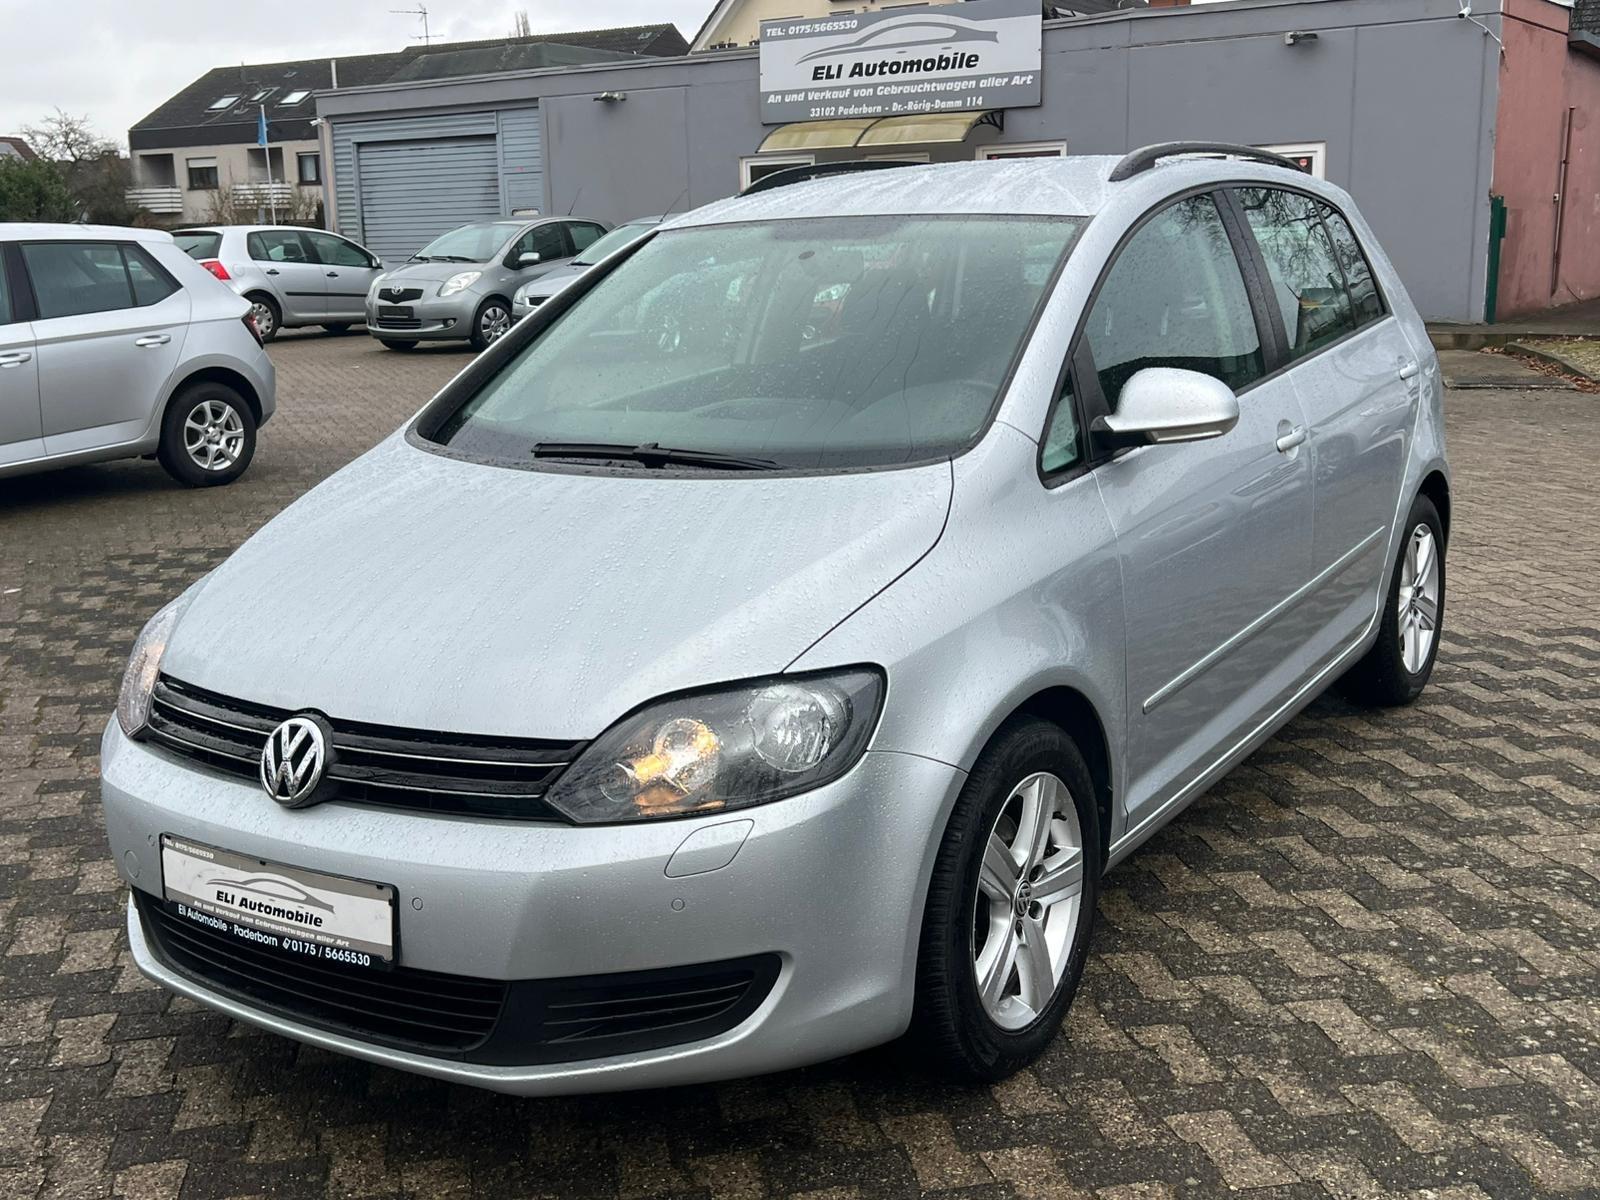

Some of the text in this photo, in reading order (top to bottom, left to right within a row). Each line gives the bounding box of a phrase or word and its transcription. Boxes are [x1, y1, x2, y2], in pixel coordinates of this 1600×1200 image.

[766, 19, 858, 37] TEL: 0175/5665530
[811, 52, 980, 81] ELI Automobile
[767, 74, 1034, 104] An und Verkauf von Gebrauchtwagen aller Art
[809, 106, 835, 117] 33102
[837, 104, 882, 116] Paderborn
[965, 96, 983, 107] 114
[216, 890, 323, 927] ELI Automobile
[178, 903, 187, 916] Eli
[187, 907, 228, 932] Automobile
[233, 924, 278, 947] Paderborn
[291, 939, 316, 956] 0175
[324, 947, 370, 966] 5665530
[215, 907, 240, 920] Verkauf
[241, 915, 254, 924] von
[255, 918, 315, 940] Gebrauchtwagen
[316, 934, 335, 944] aller
[336, 938, 350, 948] Art
